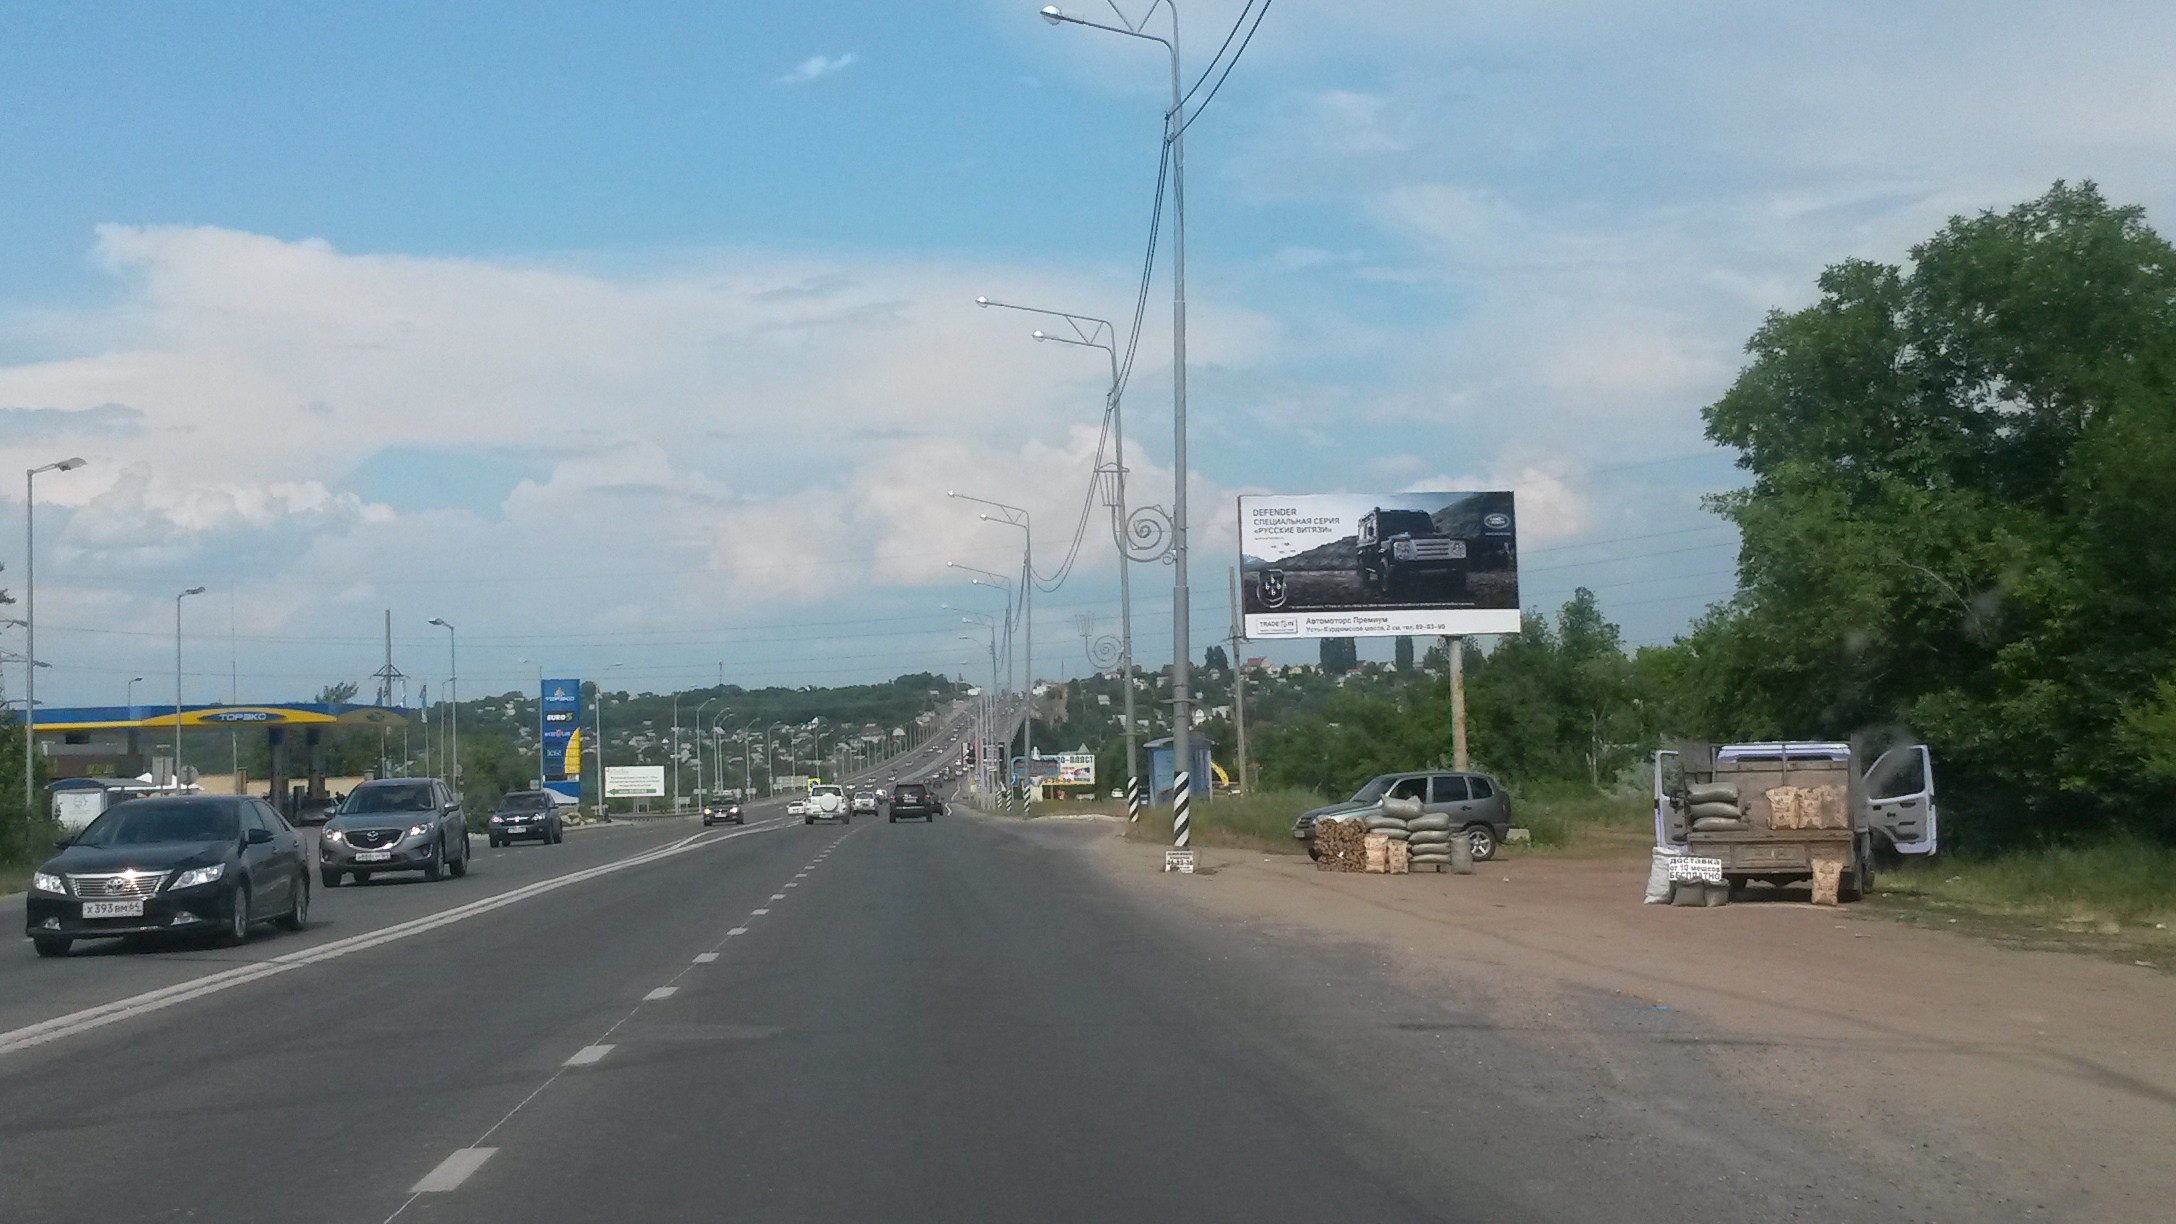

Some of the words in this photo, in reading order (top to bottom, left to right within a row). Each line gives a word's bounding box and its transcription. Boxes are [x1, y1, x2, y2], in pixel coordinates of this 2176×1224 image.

[1252, 508, 1297, 516] DEFENDER
[1253, 518, 1312, 526] СПЕЦИАЛЬНАЯ
[1313, 517, 1340, 525] СЕРИЯ
[1353, 616, 1388, 624] Премиум
